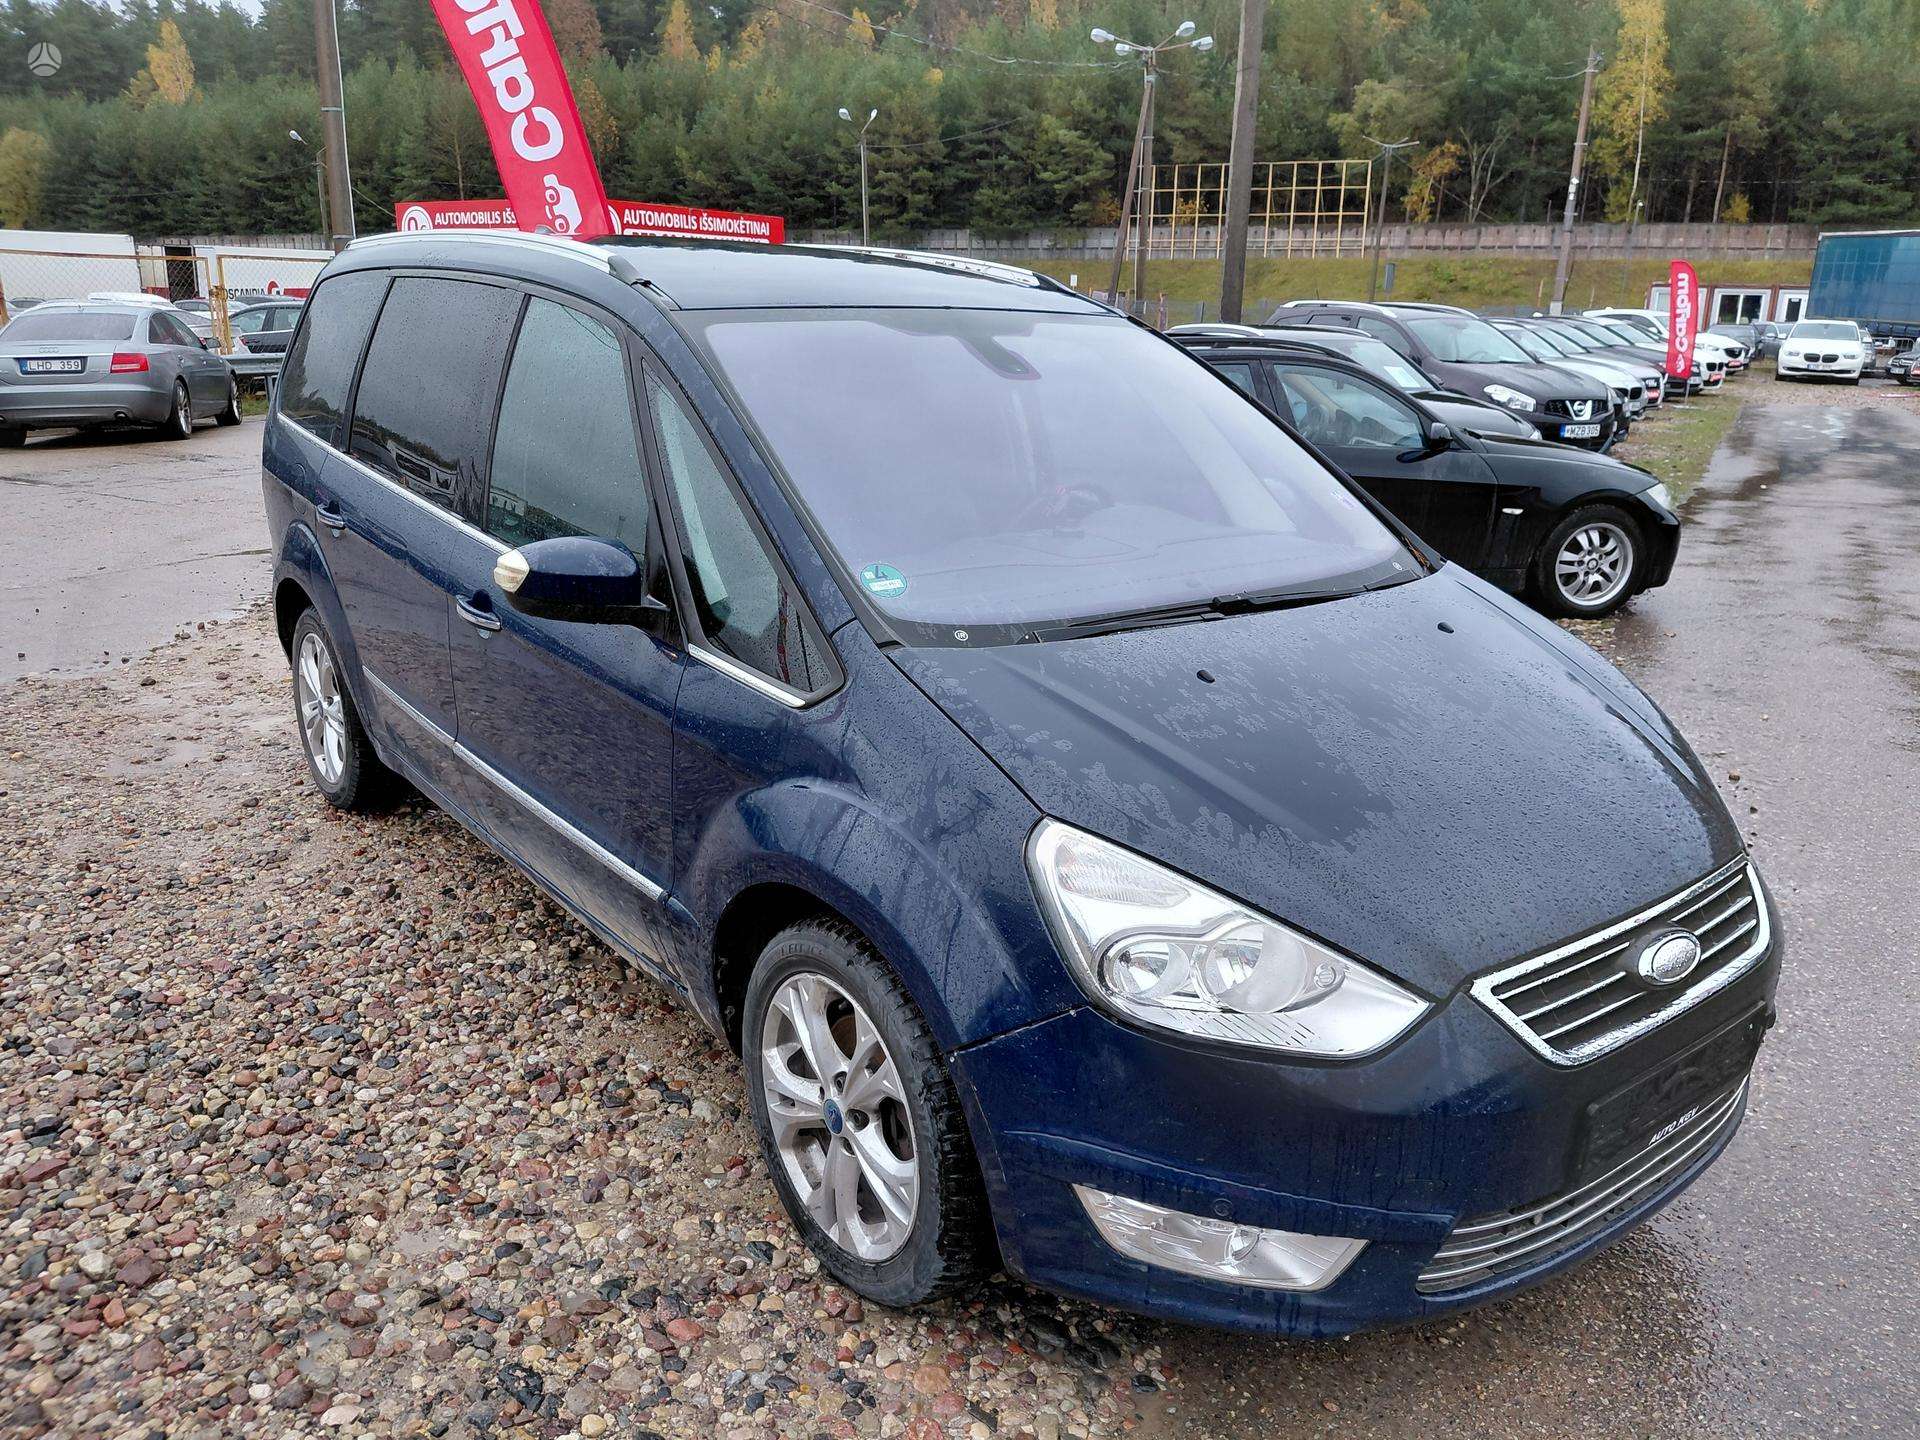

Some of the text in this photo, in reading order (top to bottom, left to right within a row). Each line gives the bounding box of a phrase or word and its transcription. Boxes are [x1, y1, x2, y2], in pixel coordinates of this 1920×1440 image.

[435, 211, 501, 225] AUTOMOBILIS
[623, 209, 770, 236] AUTOMOBILIS IŠSIMOKĖTINAI
[29, 361, 52, 370] LHD
[60, 361, 80, 370] 359
[1649, 1105, 1699, 1145] AUTO KGV
